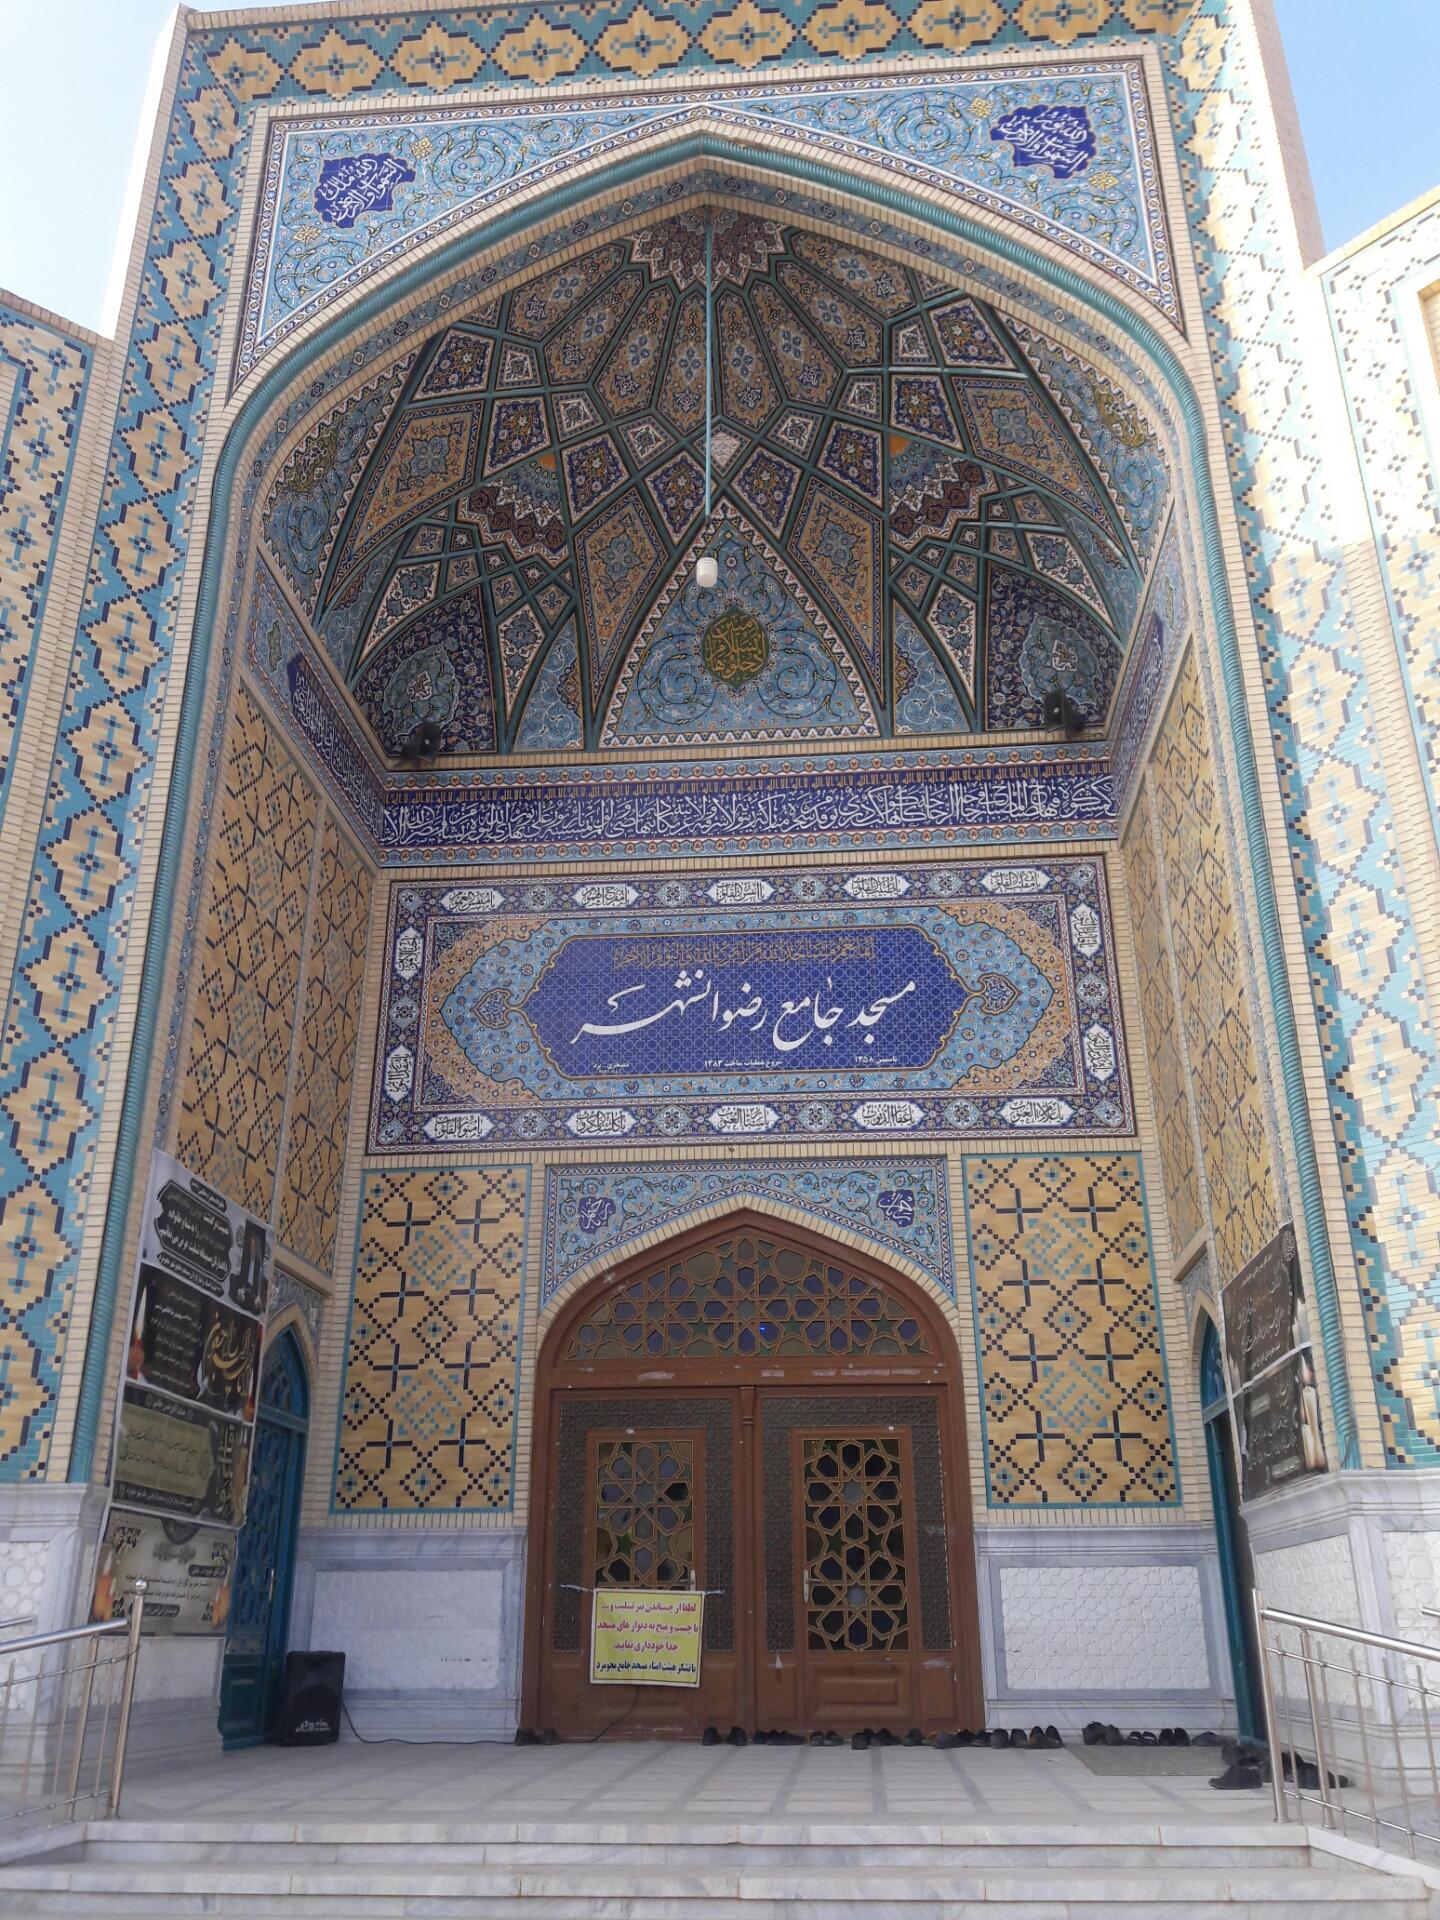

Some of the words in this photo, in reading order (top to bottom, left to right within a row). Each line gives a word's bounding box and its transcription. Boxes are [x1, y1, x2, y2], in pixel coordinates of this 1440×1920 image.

[570, 969, 768, 1044] رضوانشهر
[772, 976, 843, 1051] جامع
[847, 980, 915, 1045] مسجد
[723, 1059, 743, 1068] ساخت
[615, 1601, 635, 1611] تسلیت
[645, 1602, 673, 1613] چسباندن
[597, 1621, 616, 1630] مسجد
[617, 1620, 630, 1631] های
[631, 1620, 648, 1632] دیوار
[649, 1623, 655, 1631] به
[674, 1624, 692, 1635] چسب
[693, 1623, 699, 1632] با
[634, 1640, 664, 1652] خودداری
[617, 1660, 631, 1672] جامع
[631, 1661, 648, 1671] مسجد
[677, 1661, 690, 1675] تشکر
